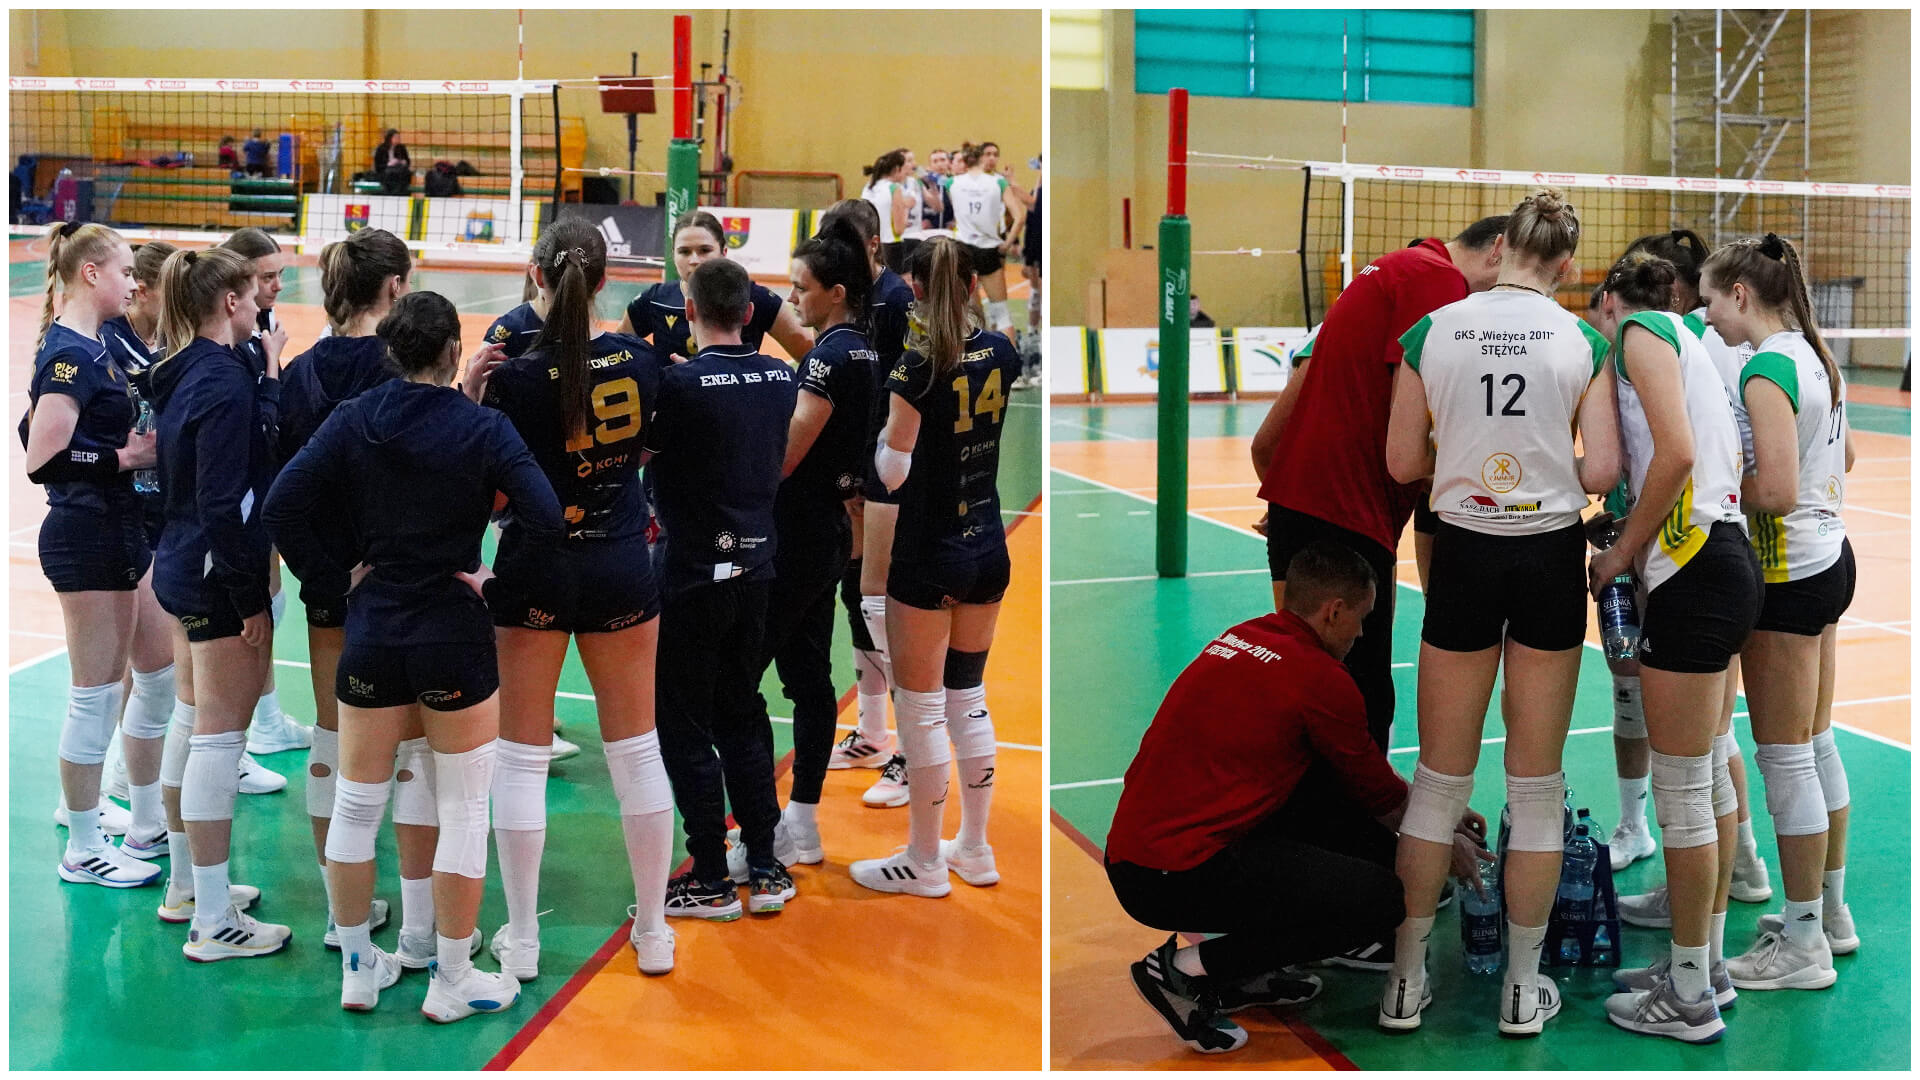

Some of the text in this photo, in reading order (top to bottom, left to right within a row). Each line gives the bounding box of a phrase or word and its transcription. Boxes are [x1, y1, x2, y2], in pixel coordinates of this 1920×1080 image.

[968, 202, 982, 215] 19
[1454, 330, 1475, 341] GKS
[1481, 344, 1527, 358] STĘŻYCA
[699, 373, 740, 387] ENEA
[742, 372, 763, 384] KS
[952, 367, 1005, 434] 14
[1480, 373, 1526, 417] 12
[1828, 401, 1842, 446] 27
